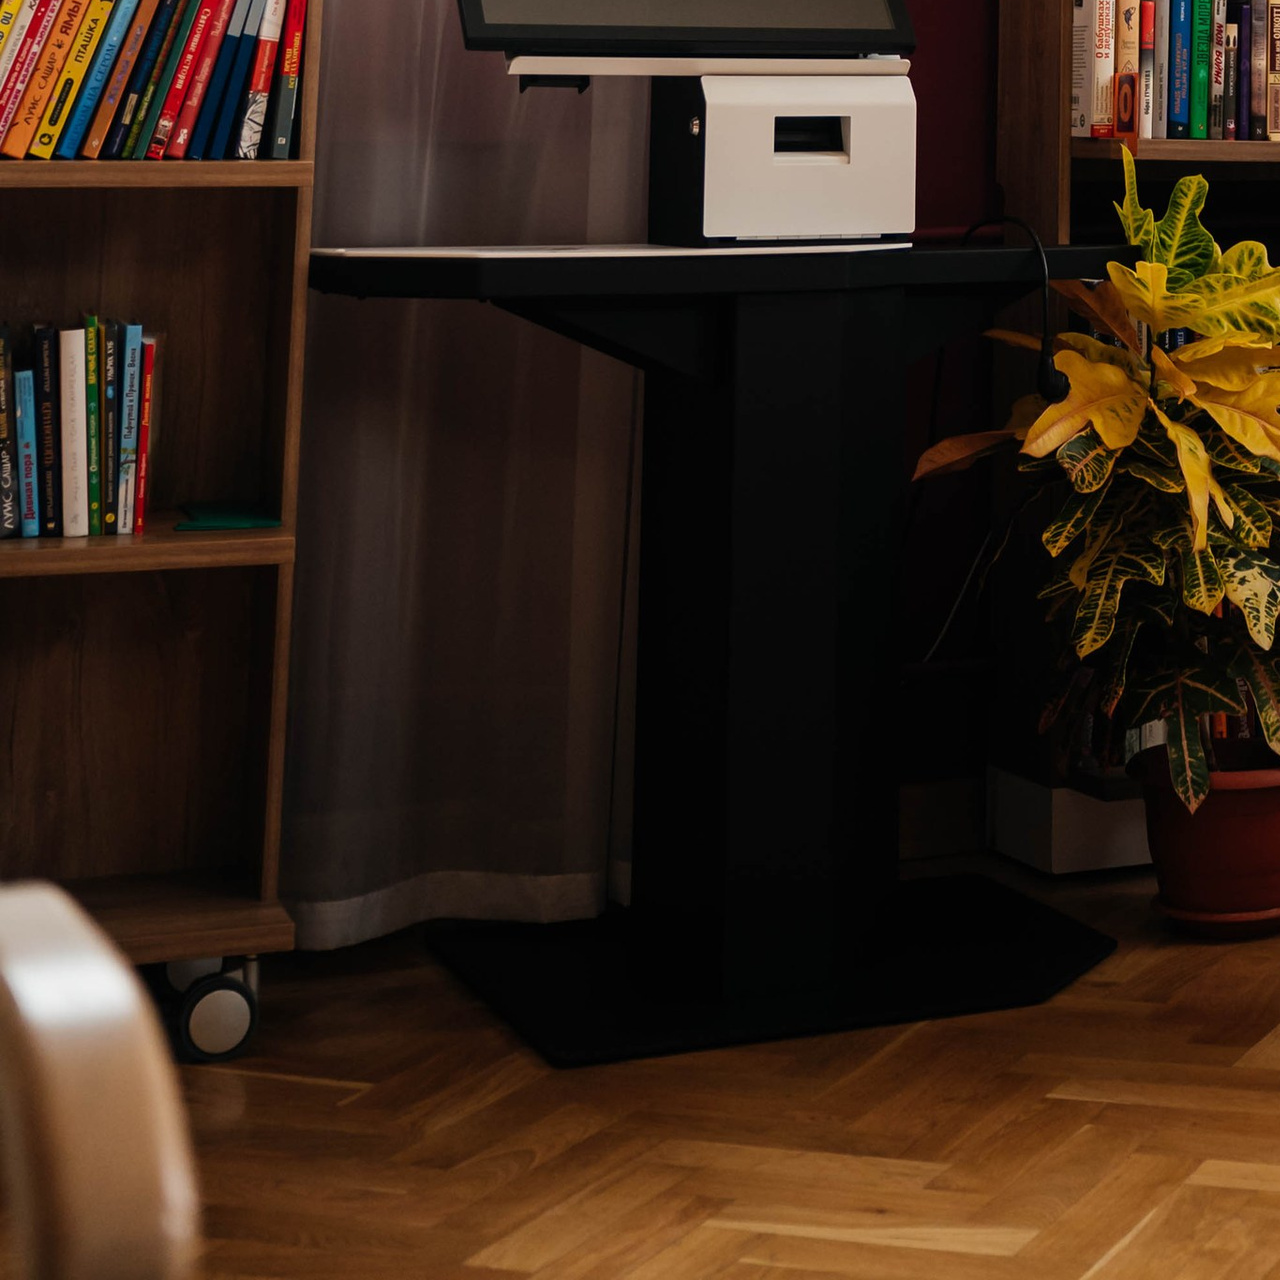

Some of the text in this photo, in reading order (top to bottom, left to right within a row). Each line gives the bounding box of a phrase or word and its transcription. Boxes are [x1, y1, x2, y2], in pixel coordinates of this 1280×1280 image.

[74, 17, 100, 64] ПТАШКА
[176, 7, 211, 90] Святочные истории
[1096, 0, 1105, 50] бабушках
[1198, 29, 1209, 66] ЗВЕЗДА
[1214, 22, 1224, 86] МОЯ ВОЙНА
[19, 51, 38, 86] БАРОНА
[24, 0, 82, 126] ЛУИС САШАР ЯМЫ
[86, 86, 101, 101] НА
[94, 42, 118, 83] СЕРОМ
[1, 450, 16, 529] ЛУИС САШАР
[24, 453, 36, 521] Дивная пора
